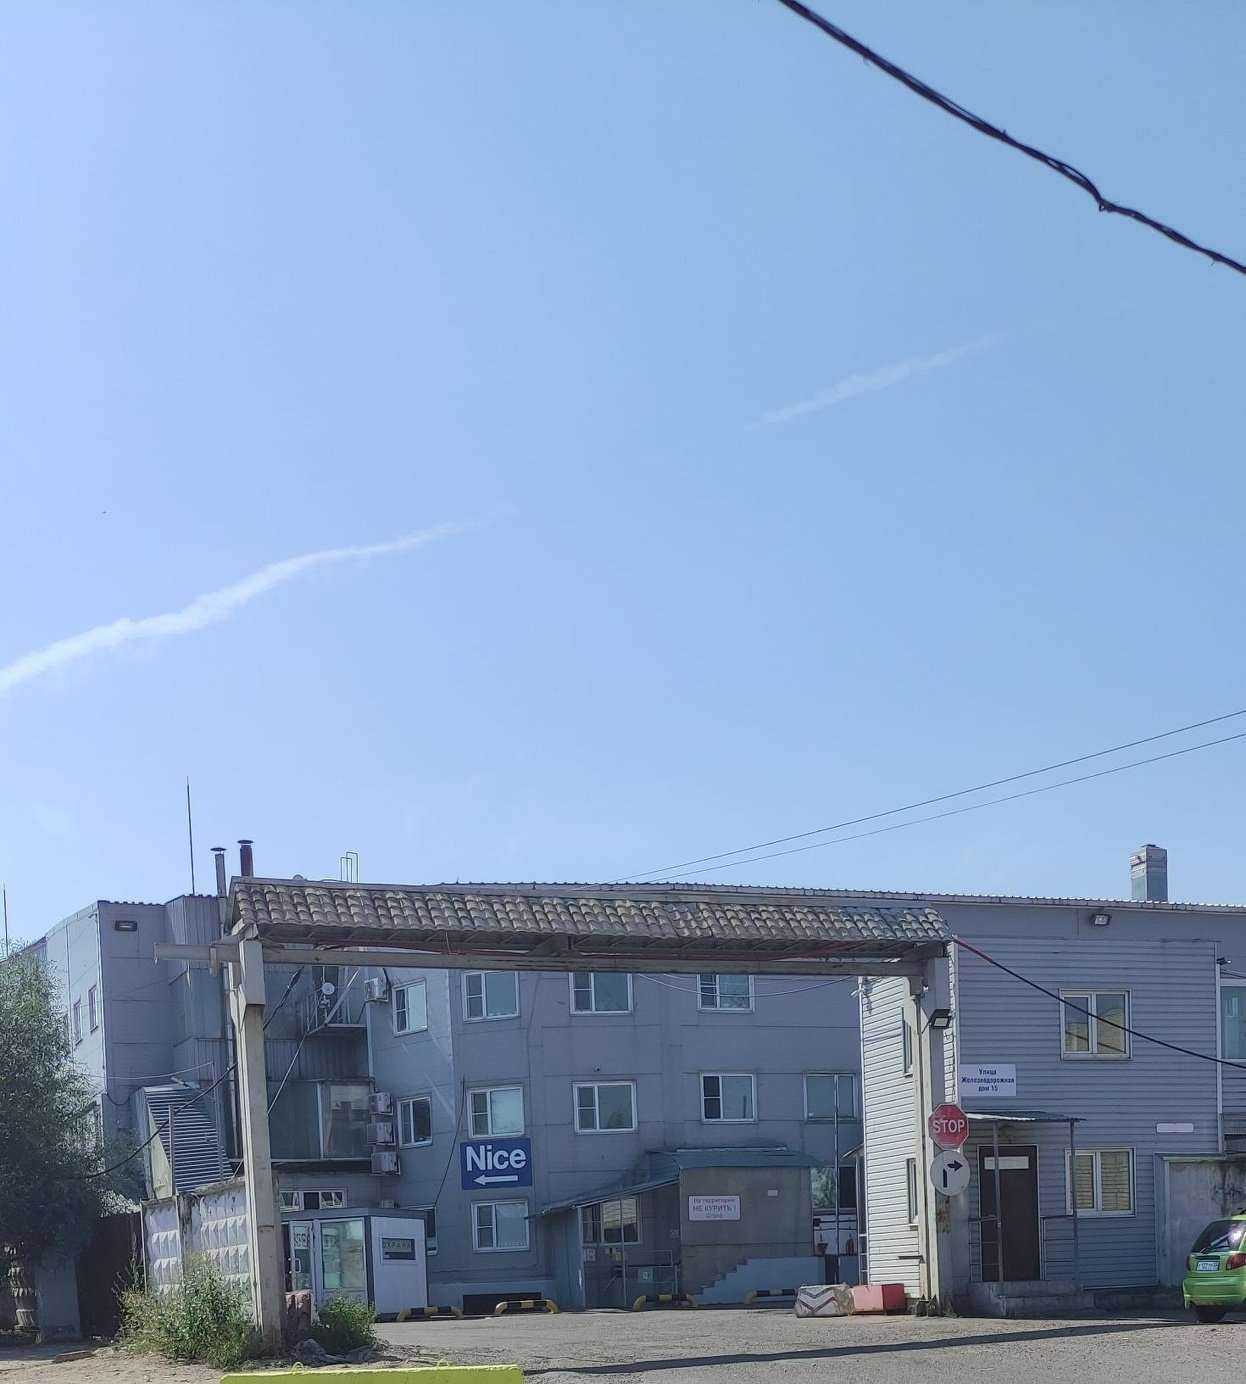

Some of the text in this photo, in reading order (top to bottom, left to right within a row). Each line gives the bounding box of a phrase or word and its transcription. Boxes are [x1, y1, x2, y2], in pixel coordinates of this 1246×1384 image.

[978, 1067, 997, 1075] Улица
[932, 1119, 965, 1133] STOP
[465, 1144, 527, 1172] Nice
